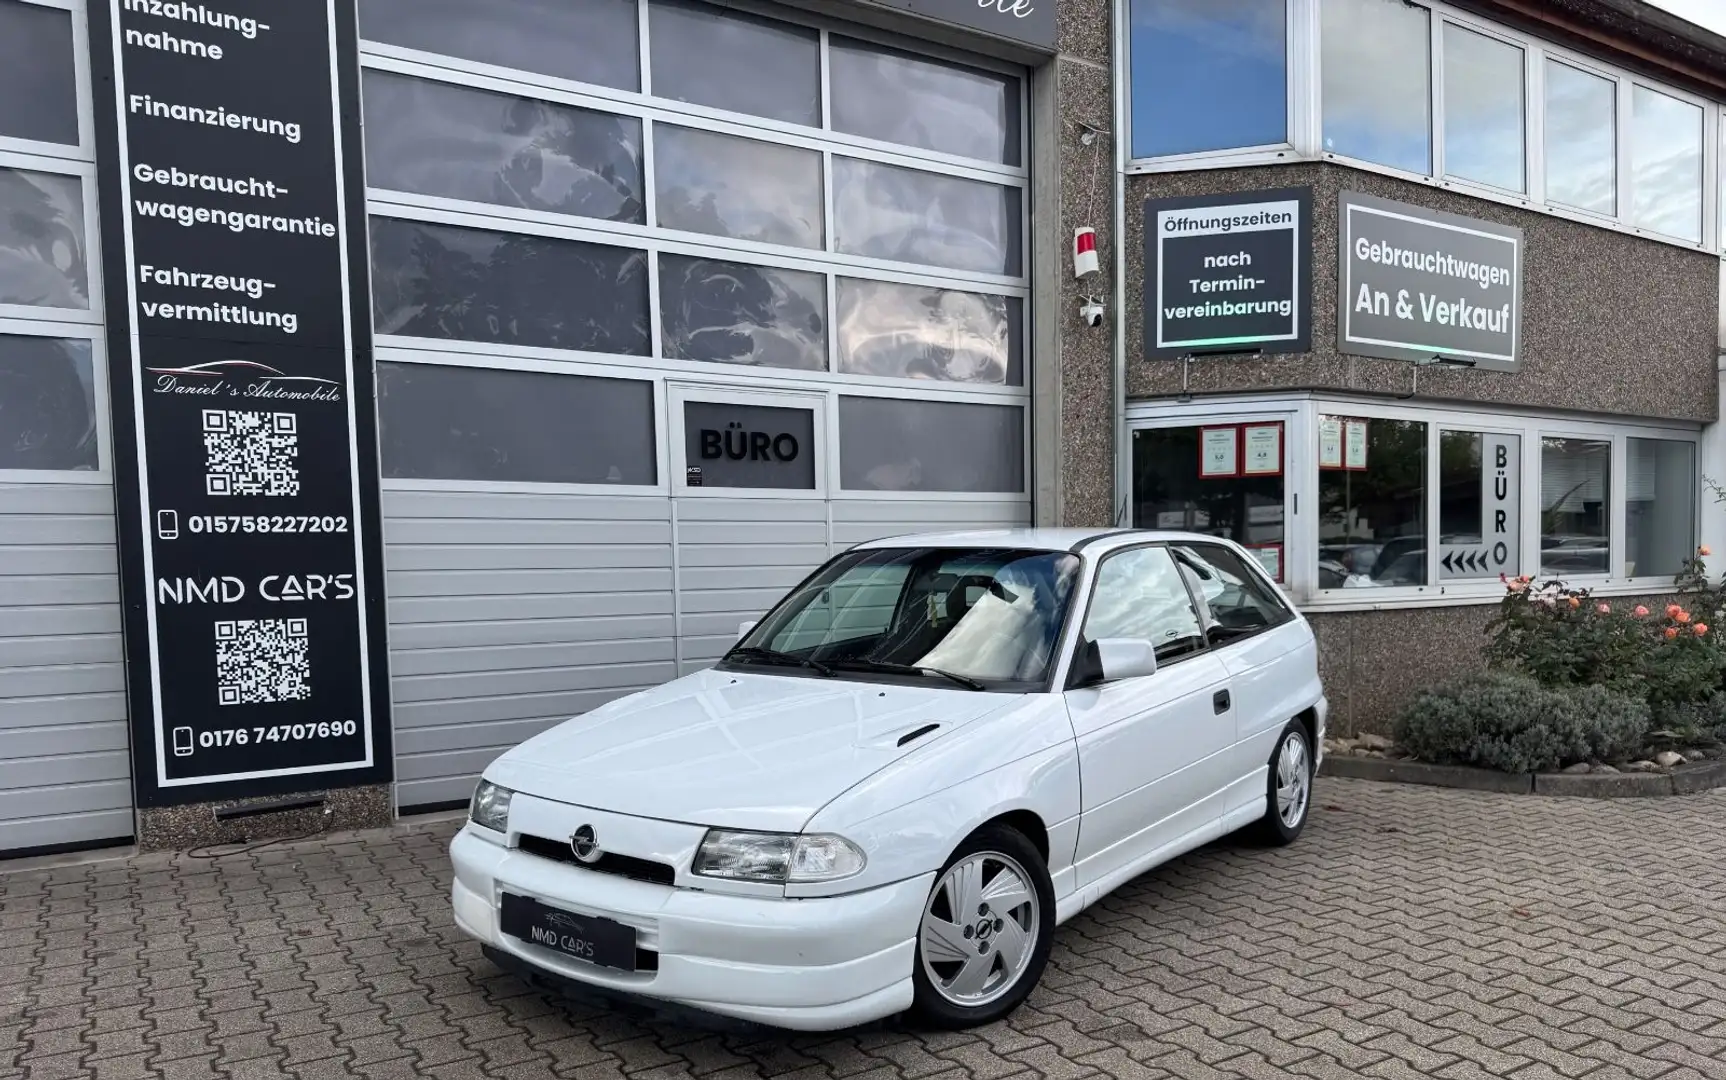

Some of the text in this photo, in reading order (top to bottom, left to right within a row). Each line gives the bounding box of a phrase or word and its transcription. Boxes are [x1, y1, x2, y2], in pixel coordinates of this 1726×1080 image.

[126, 29, 223, 60] nahme
[130, 95, 300, 143] Finanzierung
[134, 164, 288, 198] Gebraucht-
[135, 200, 336, 237] wagengarantie
[1164, 210, 1292, 232] Öffnungszeiten
[1204, 251, 1252, 268] nach
[1355, 237, 1510, 289] Gebrauchtwagen
[141, 265, 276, 298] Fahrzeug-
[1189, 277, 1265, 294] Termin-
[141, 302, 298, 333] vermittlung
[1164, 298, 1292, 319] vereinbarung
[1355, 283, 1510, 333] An & Verkauf
[243, 381, 340, 401] Automobile
[701, 422, 799, 462] BÜRO
[1493, 444, 1508, 566] BÜRO
[188, 515, 348, 533] 015758227202
[158, 574, 354, 604] NMD CAR'S
[199, 720, 357, 748] 0176 74707690
[531, 925, 594, 956] NMD CAR'S
